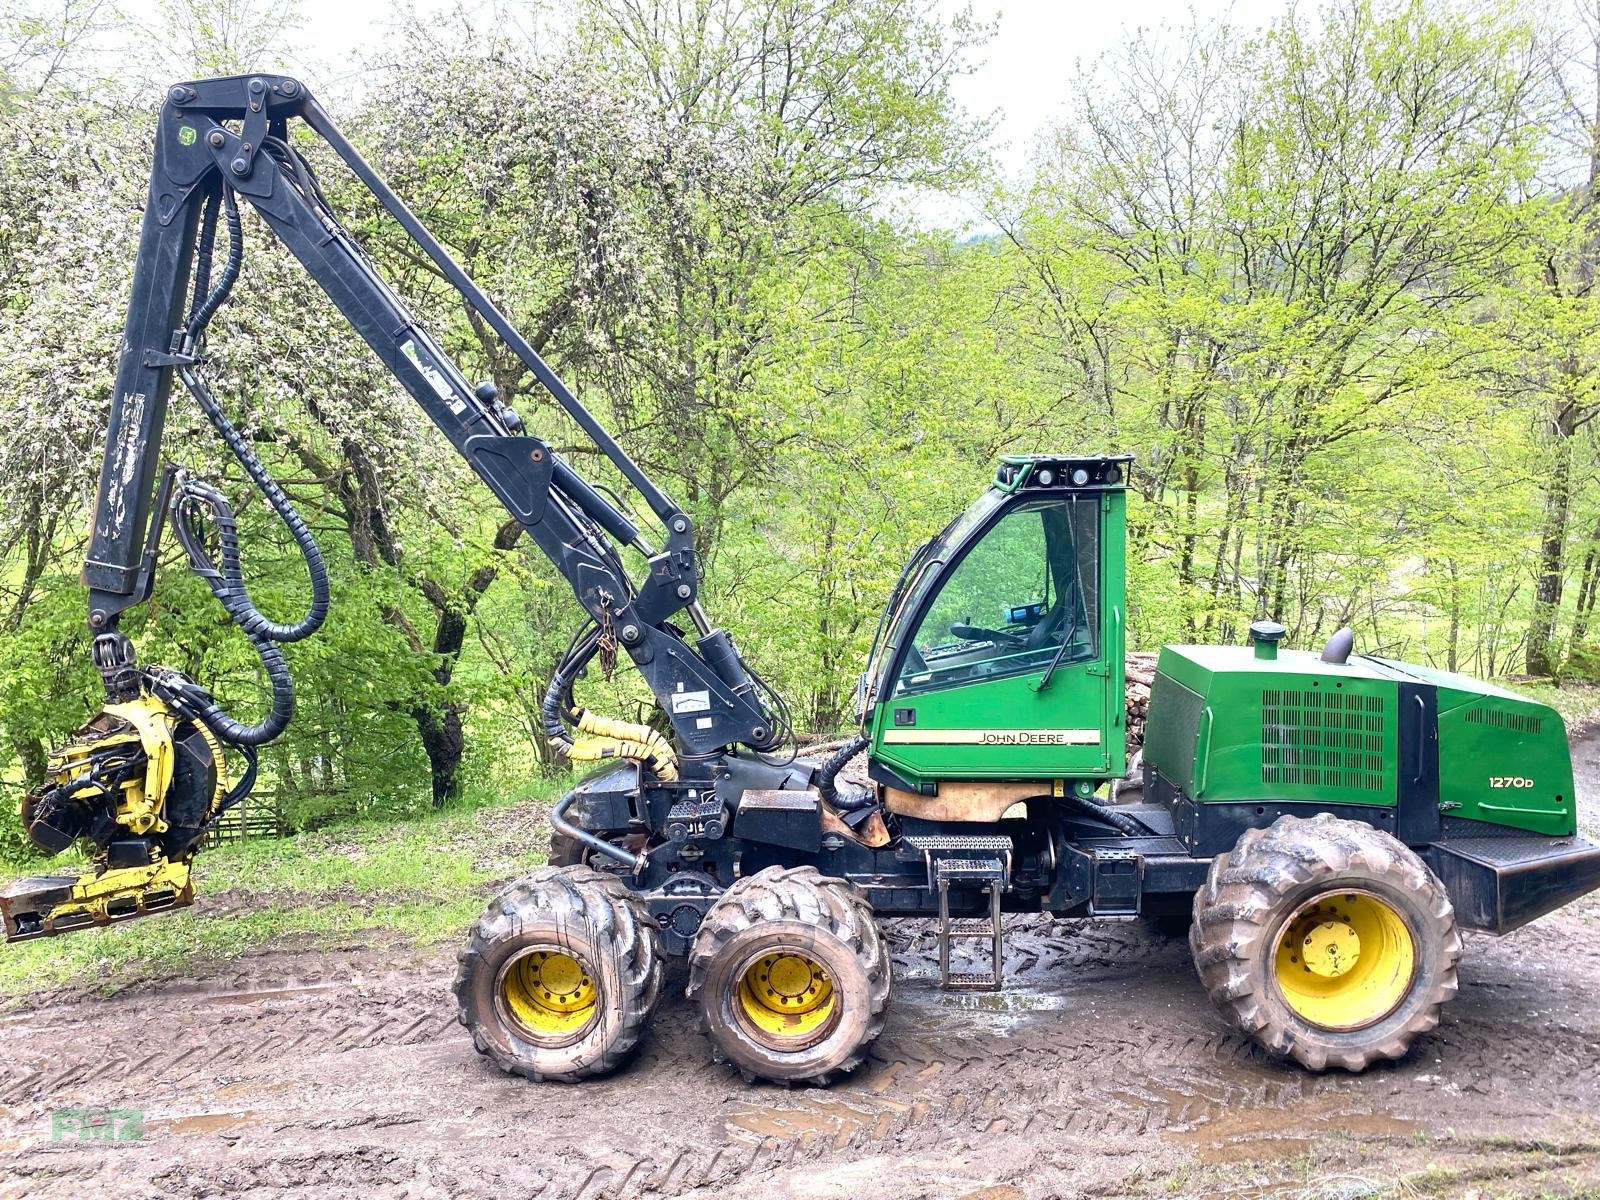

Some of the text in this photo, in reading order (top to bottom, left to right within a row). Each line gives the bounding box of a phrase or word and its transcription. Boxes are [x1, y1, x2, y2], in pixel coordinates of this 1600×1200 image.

[979, 732, 1064, 744] JOHN DEERE
[1489, 777, 1534, 788] 1270D
